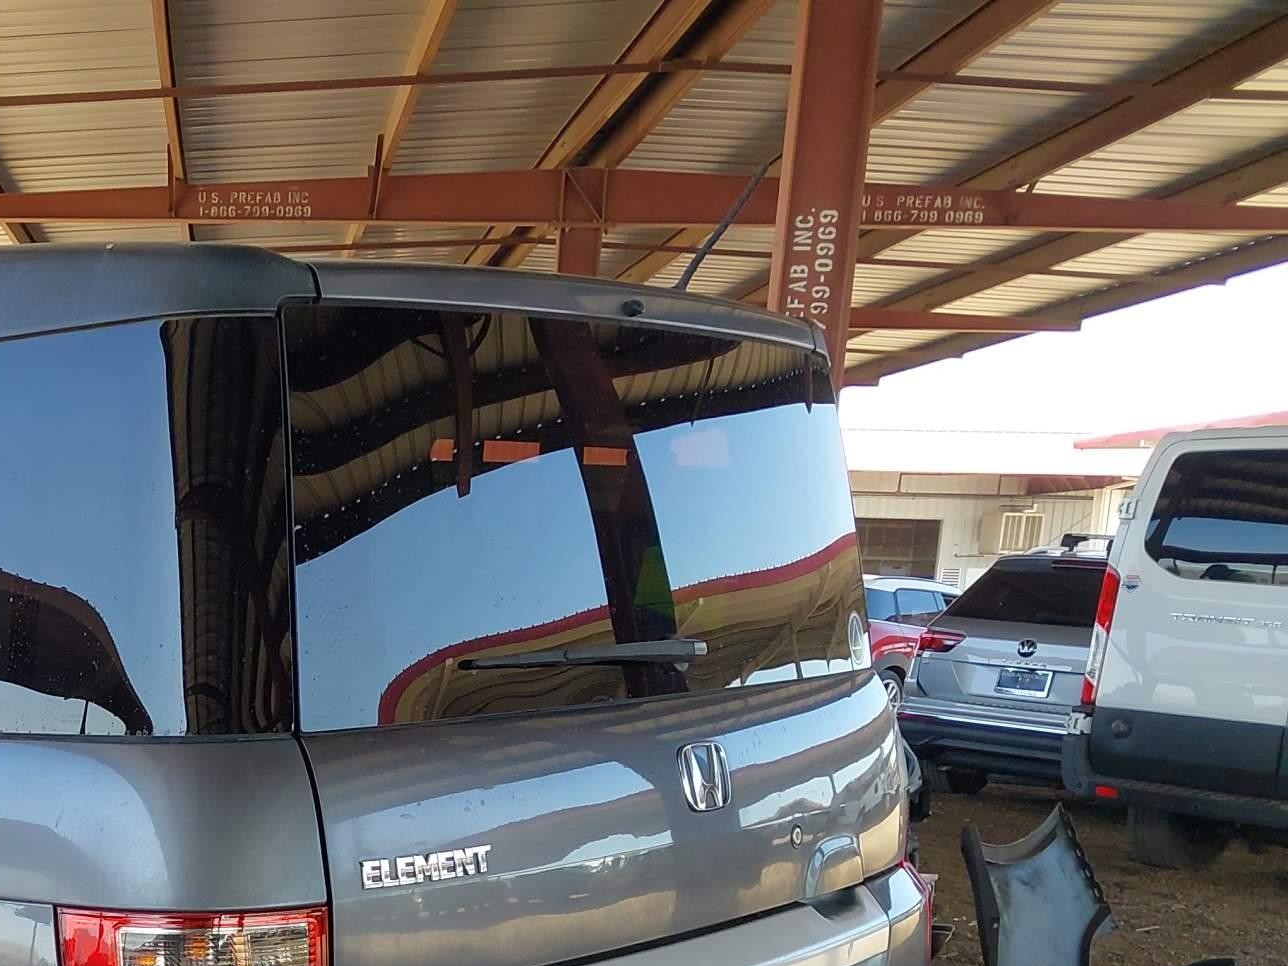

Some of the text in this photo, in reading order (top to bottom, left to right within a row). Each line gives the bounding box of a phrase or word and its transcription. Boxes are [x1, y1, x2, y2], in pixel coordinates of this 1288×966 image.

[230, 191, 281, 204] PREFAB
[896, 195, 952, 208] PREFAB
[792, 207, 816, 251] INC.
[360, 844, 492, 890] ELEMENT
